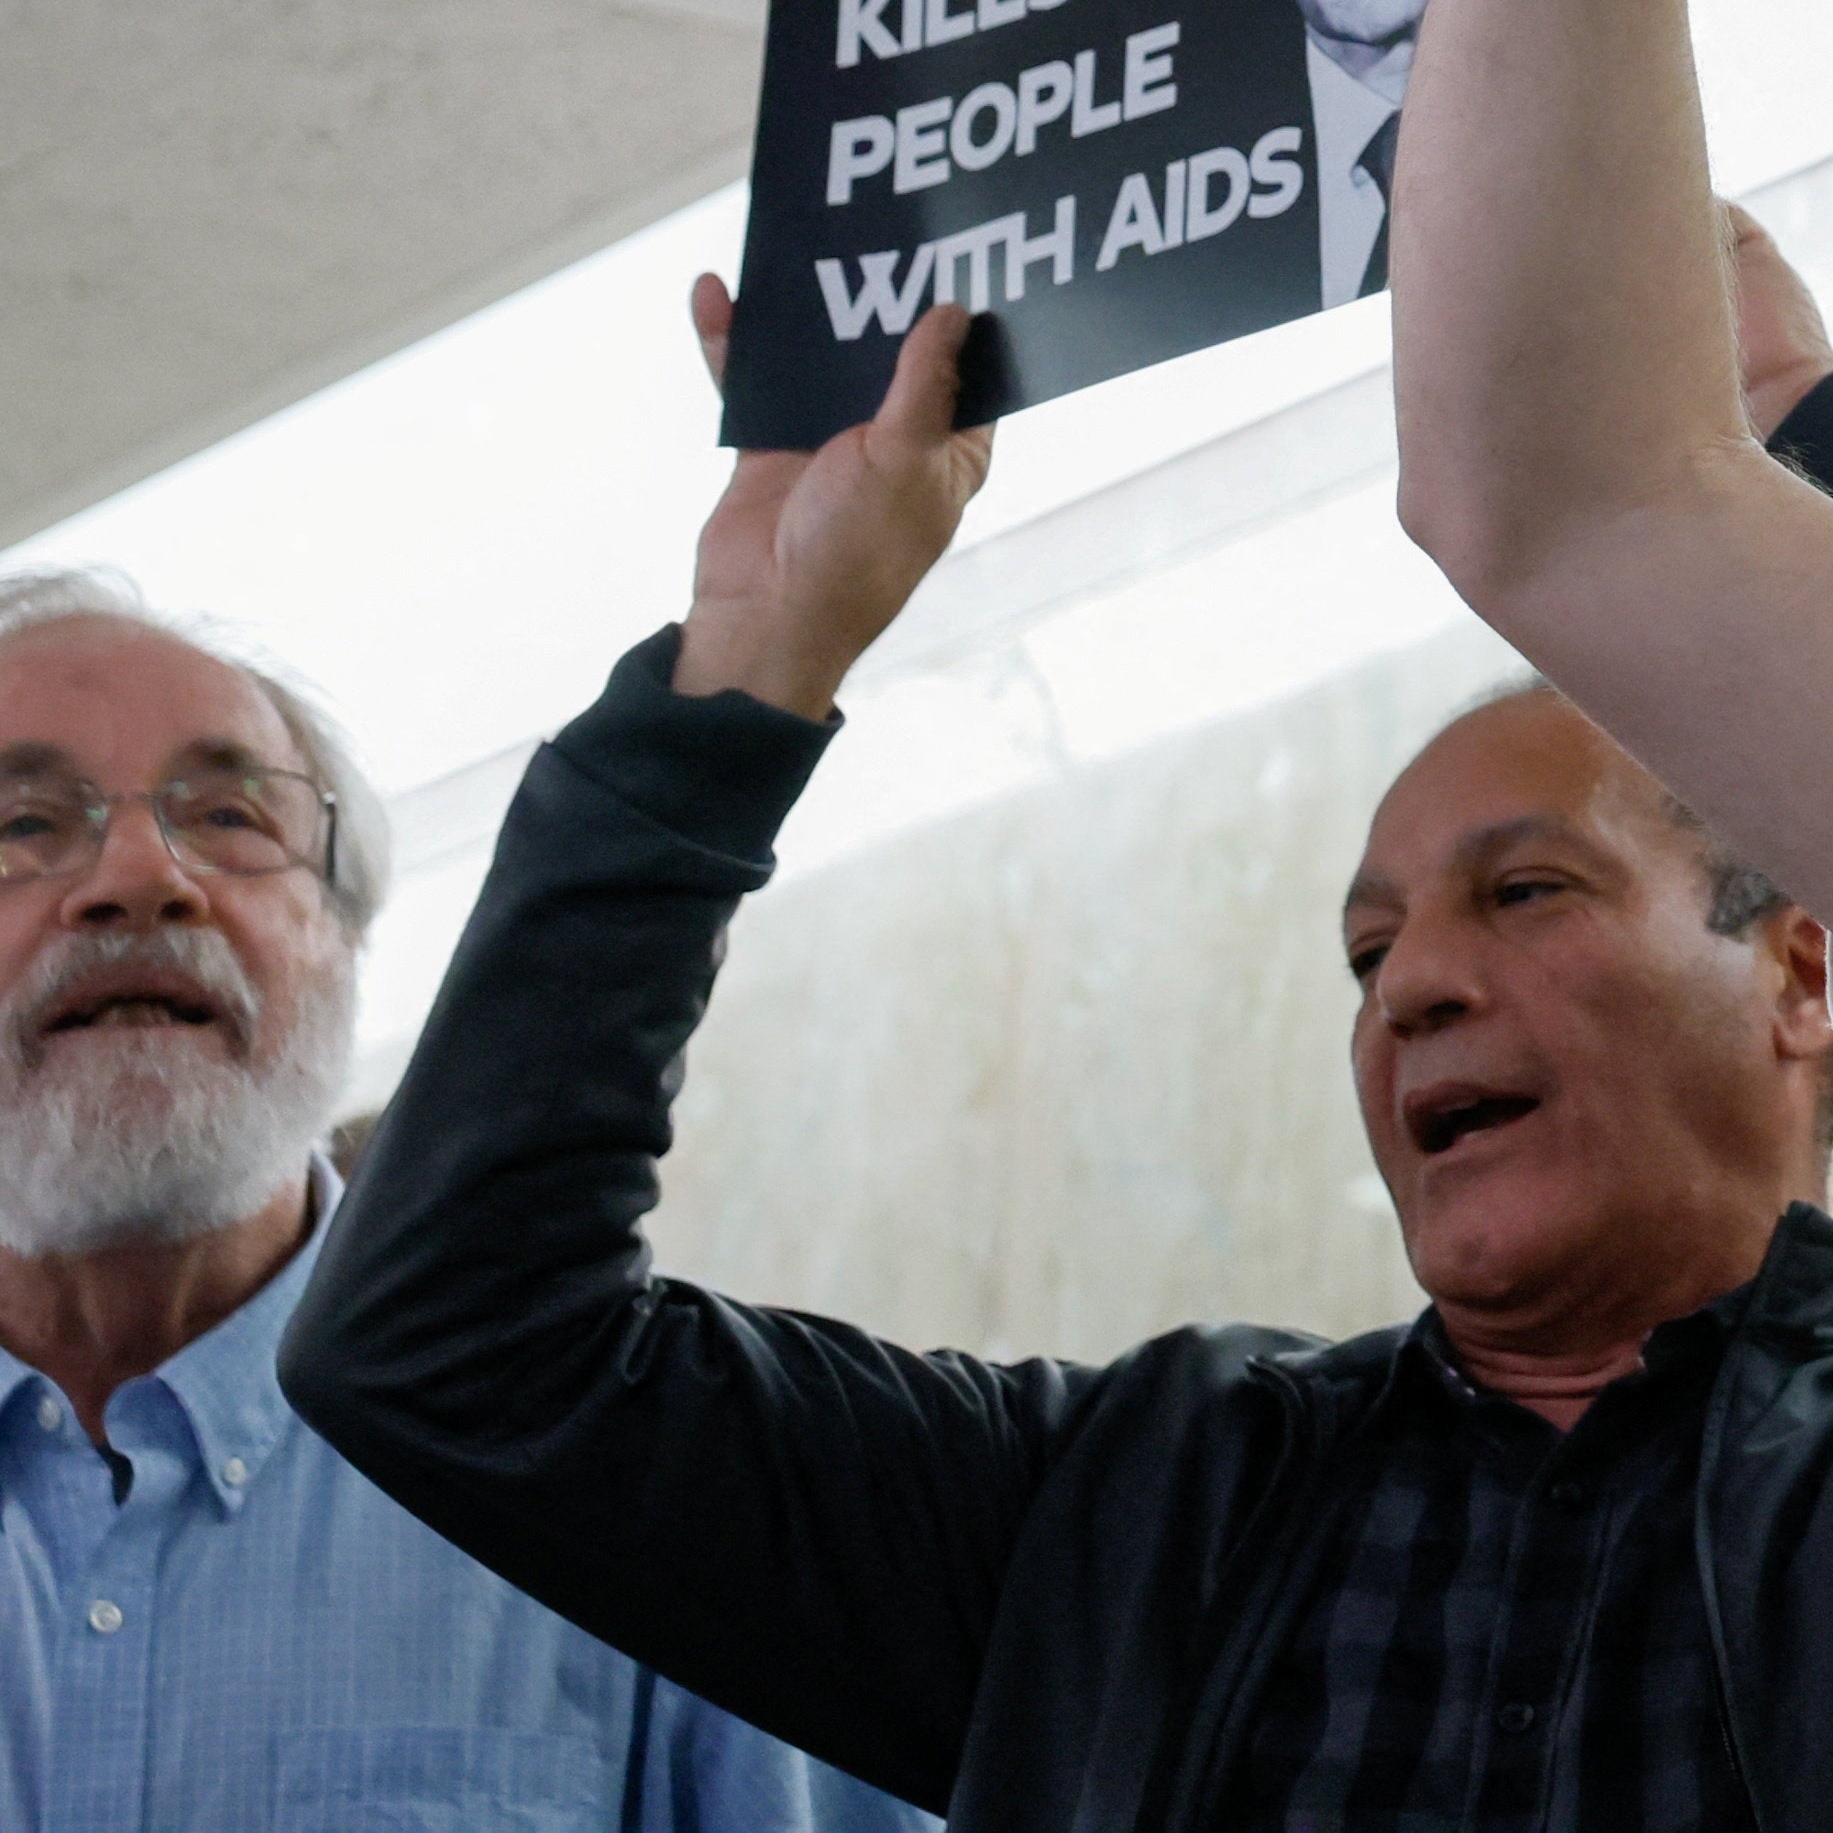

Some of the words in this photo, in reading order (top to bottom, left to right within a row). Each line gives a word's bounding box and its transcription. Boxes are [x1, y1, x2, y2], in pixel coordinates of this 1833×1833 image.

[824, 19, 1183, 207] PEOPLE
[813, 192, 1078, 342] WITH
[1092, 124, 1306, 274] AIDS
